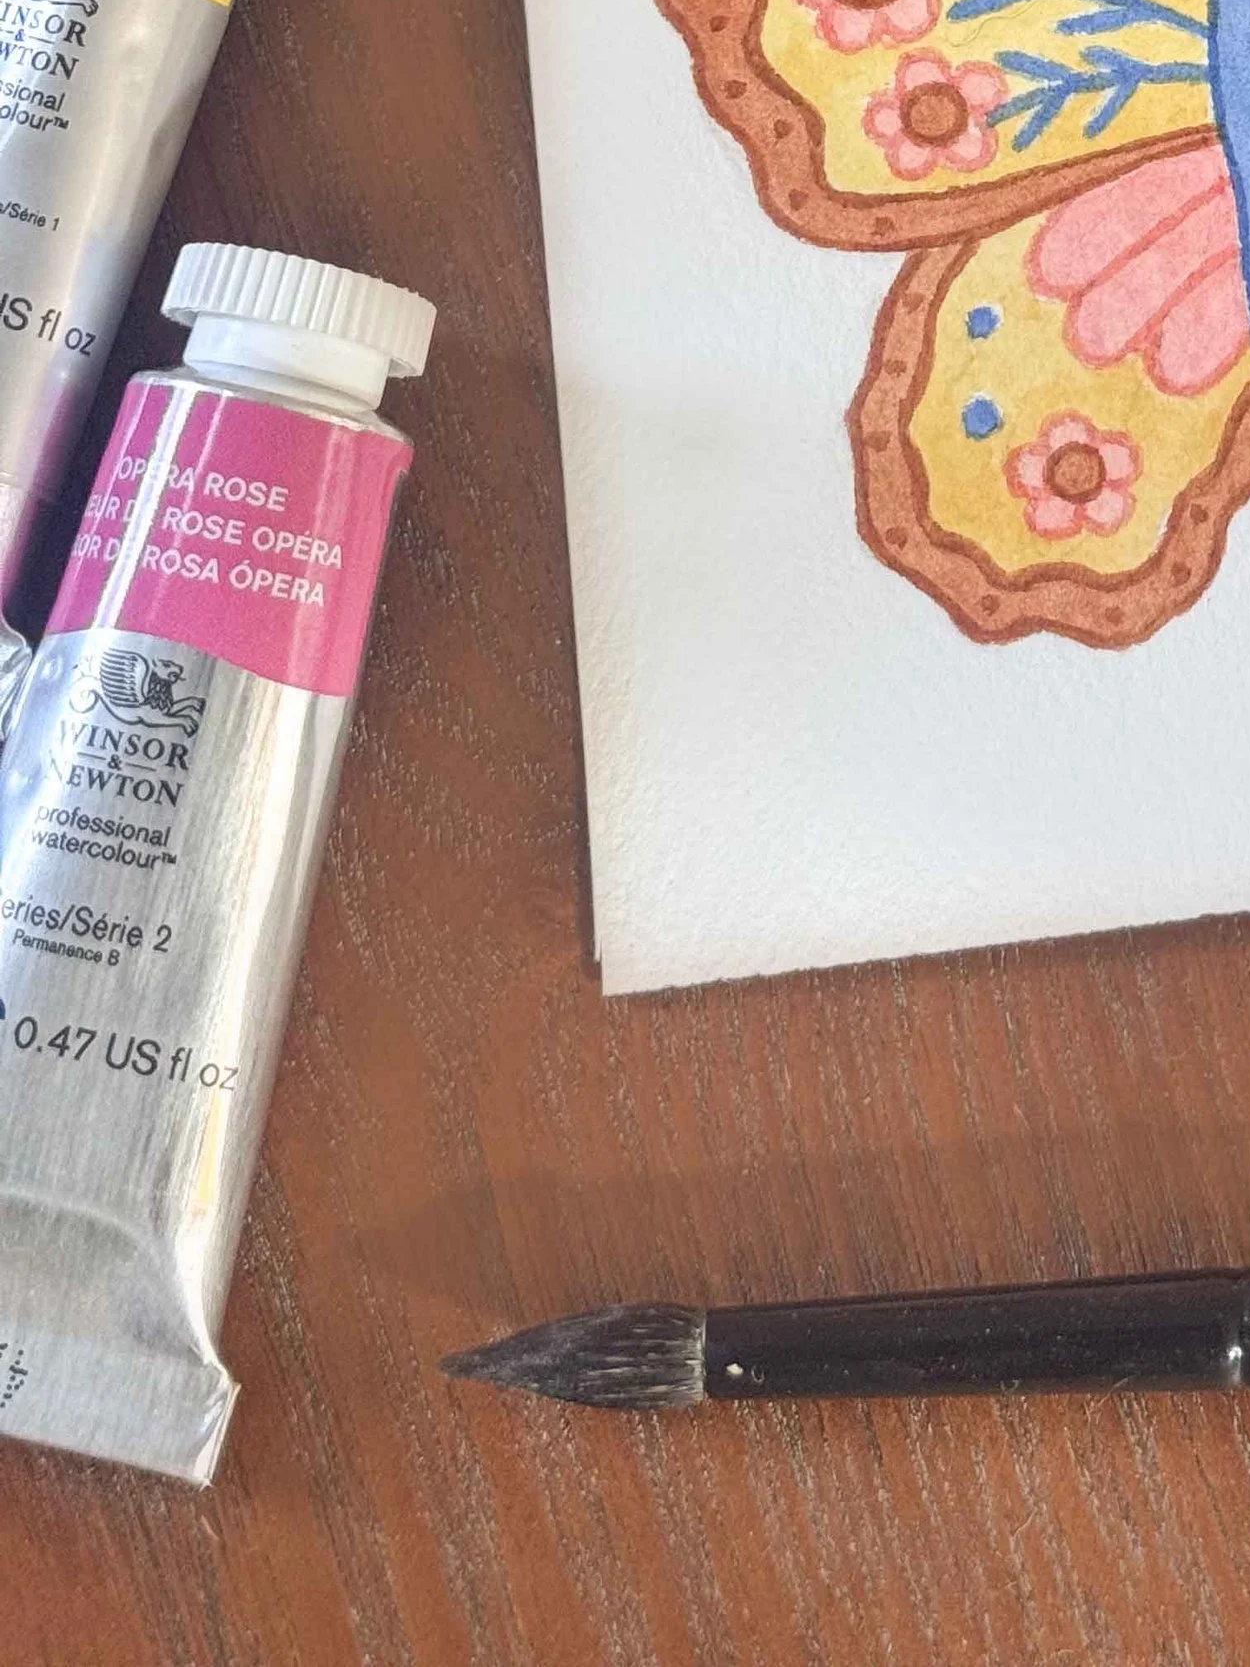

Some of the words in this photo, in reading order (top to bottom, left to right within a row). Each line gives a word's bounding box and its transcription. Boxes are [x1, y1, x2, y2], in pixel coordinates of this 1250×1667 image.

[52, 217, 60, 231] 1
[38, 308, 62, 341] fl
[65, 327, 96, 356] oz
[117, 455, 195, 491] OPRA
[203, 475, 289, 512] ROSE
[162, 506, 245, 545] ROSE
[252, 526, 342, 569] OPÉRA
[143, 545, 219, 582] ROSA
[229, 560, 325, 607] ÓPERA
[107, 754, 122, 770] &
[35, 805, 171, 847] professional
[12, 928, 103, 963] Permanence
[108, 948, 120, 966] B
[153, 924, 172, 952] 2
[14, 1016, 97, 1060] 0.47
[105, 1033, 161, 1075] US
[169, 1047, 192, 1081] fl
[200, 1063, 239, 1091] oz
